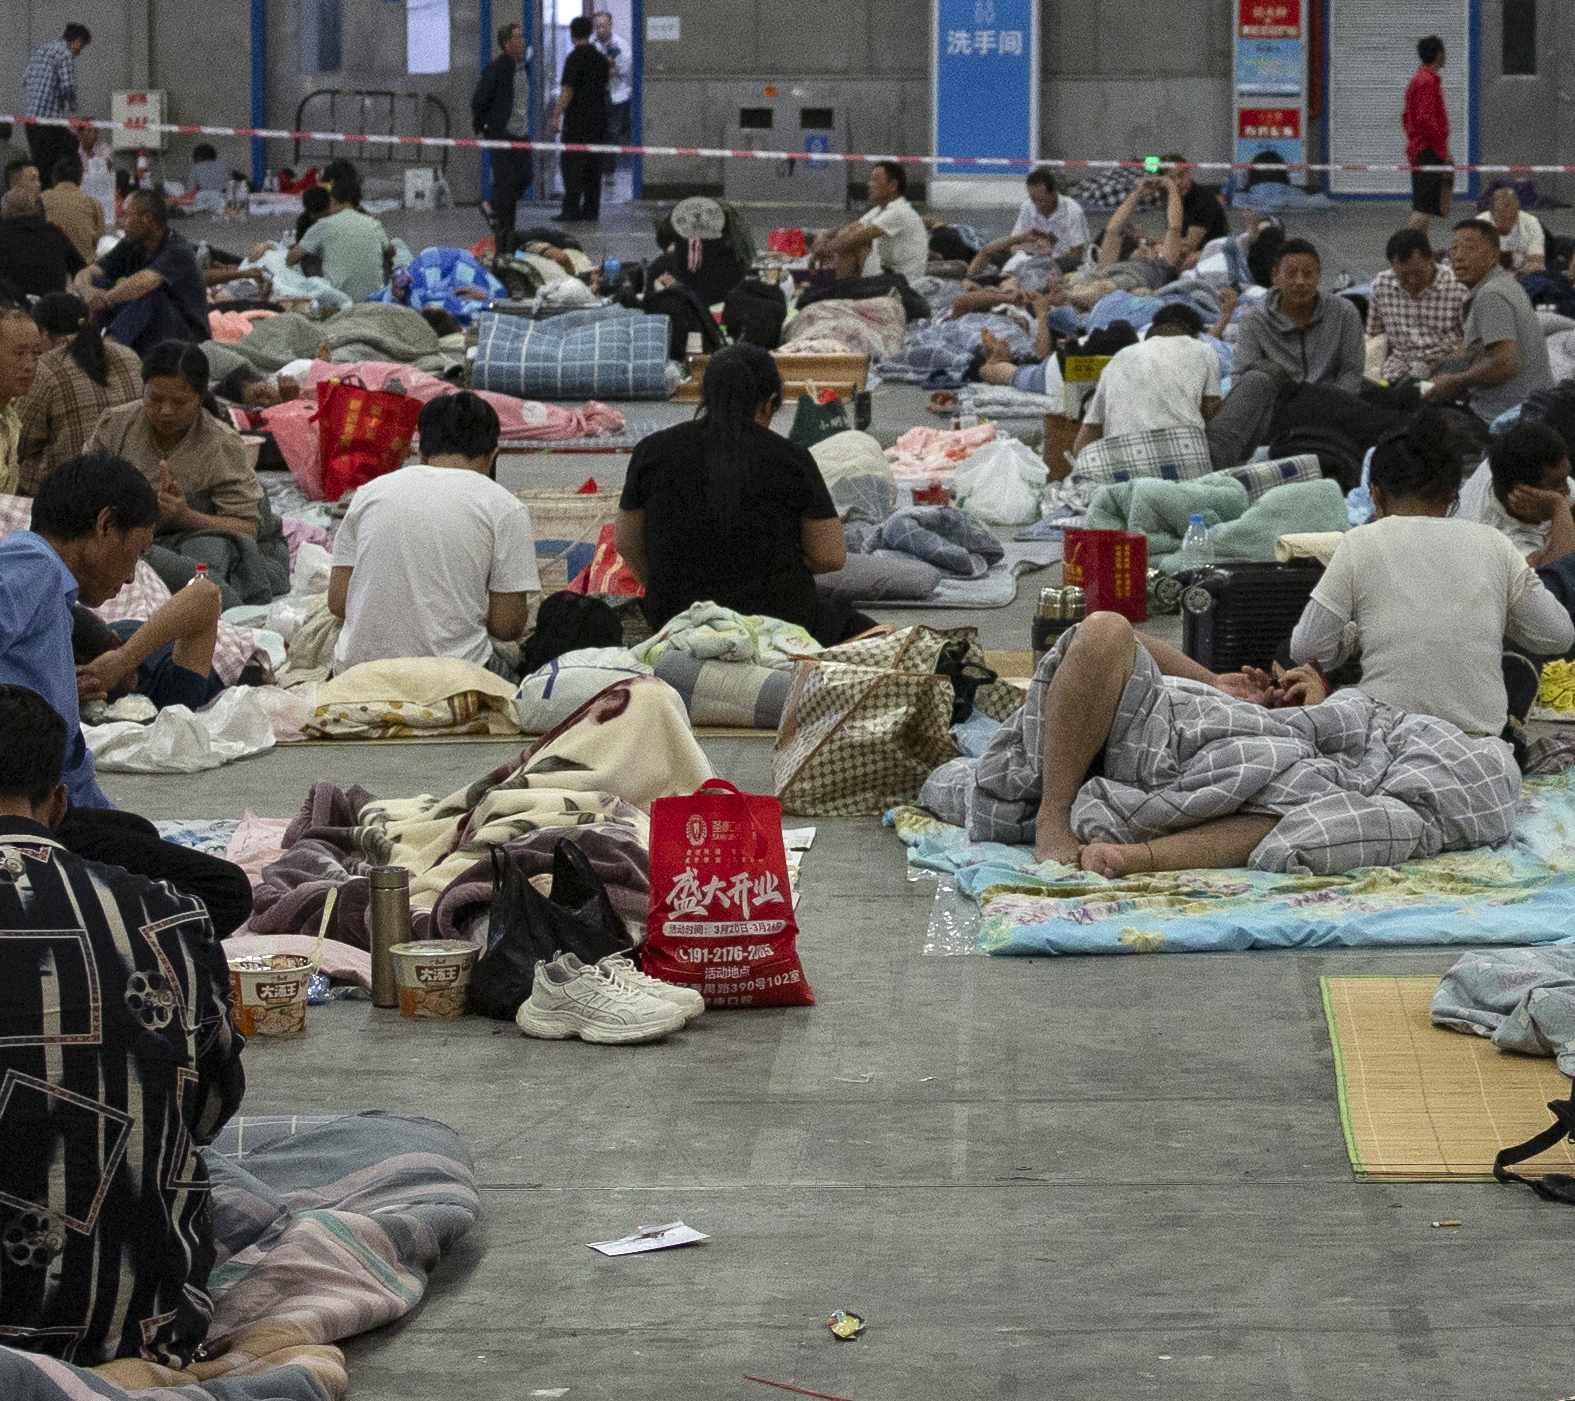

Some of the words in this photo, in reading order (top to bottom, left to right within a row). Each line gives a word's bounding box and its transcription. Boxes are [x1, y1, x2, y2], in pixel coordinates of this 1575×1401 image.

[947, 30, 1023, 56] 洗手间
[664, 866, 785, 921] 盛大开业
[704, 965, 751, 980] 活动地点
